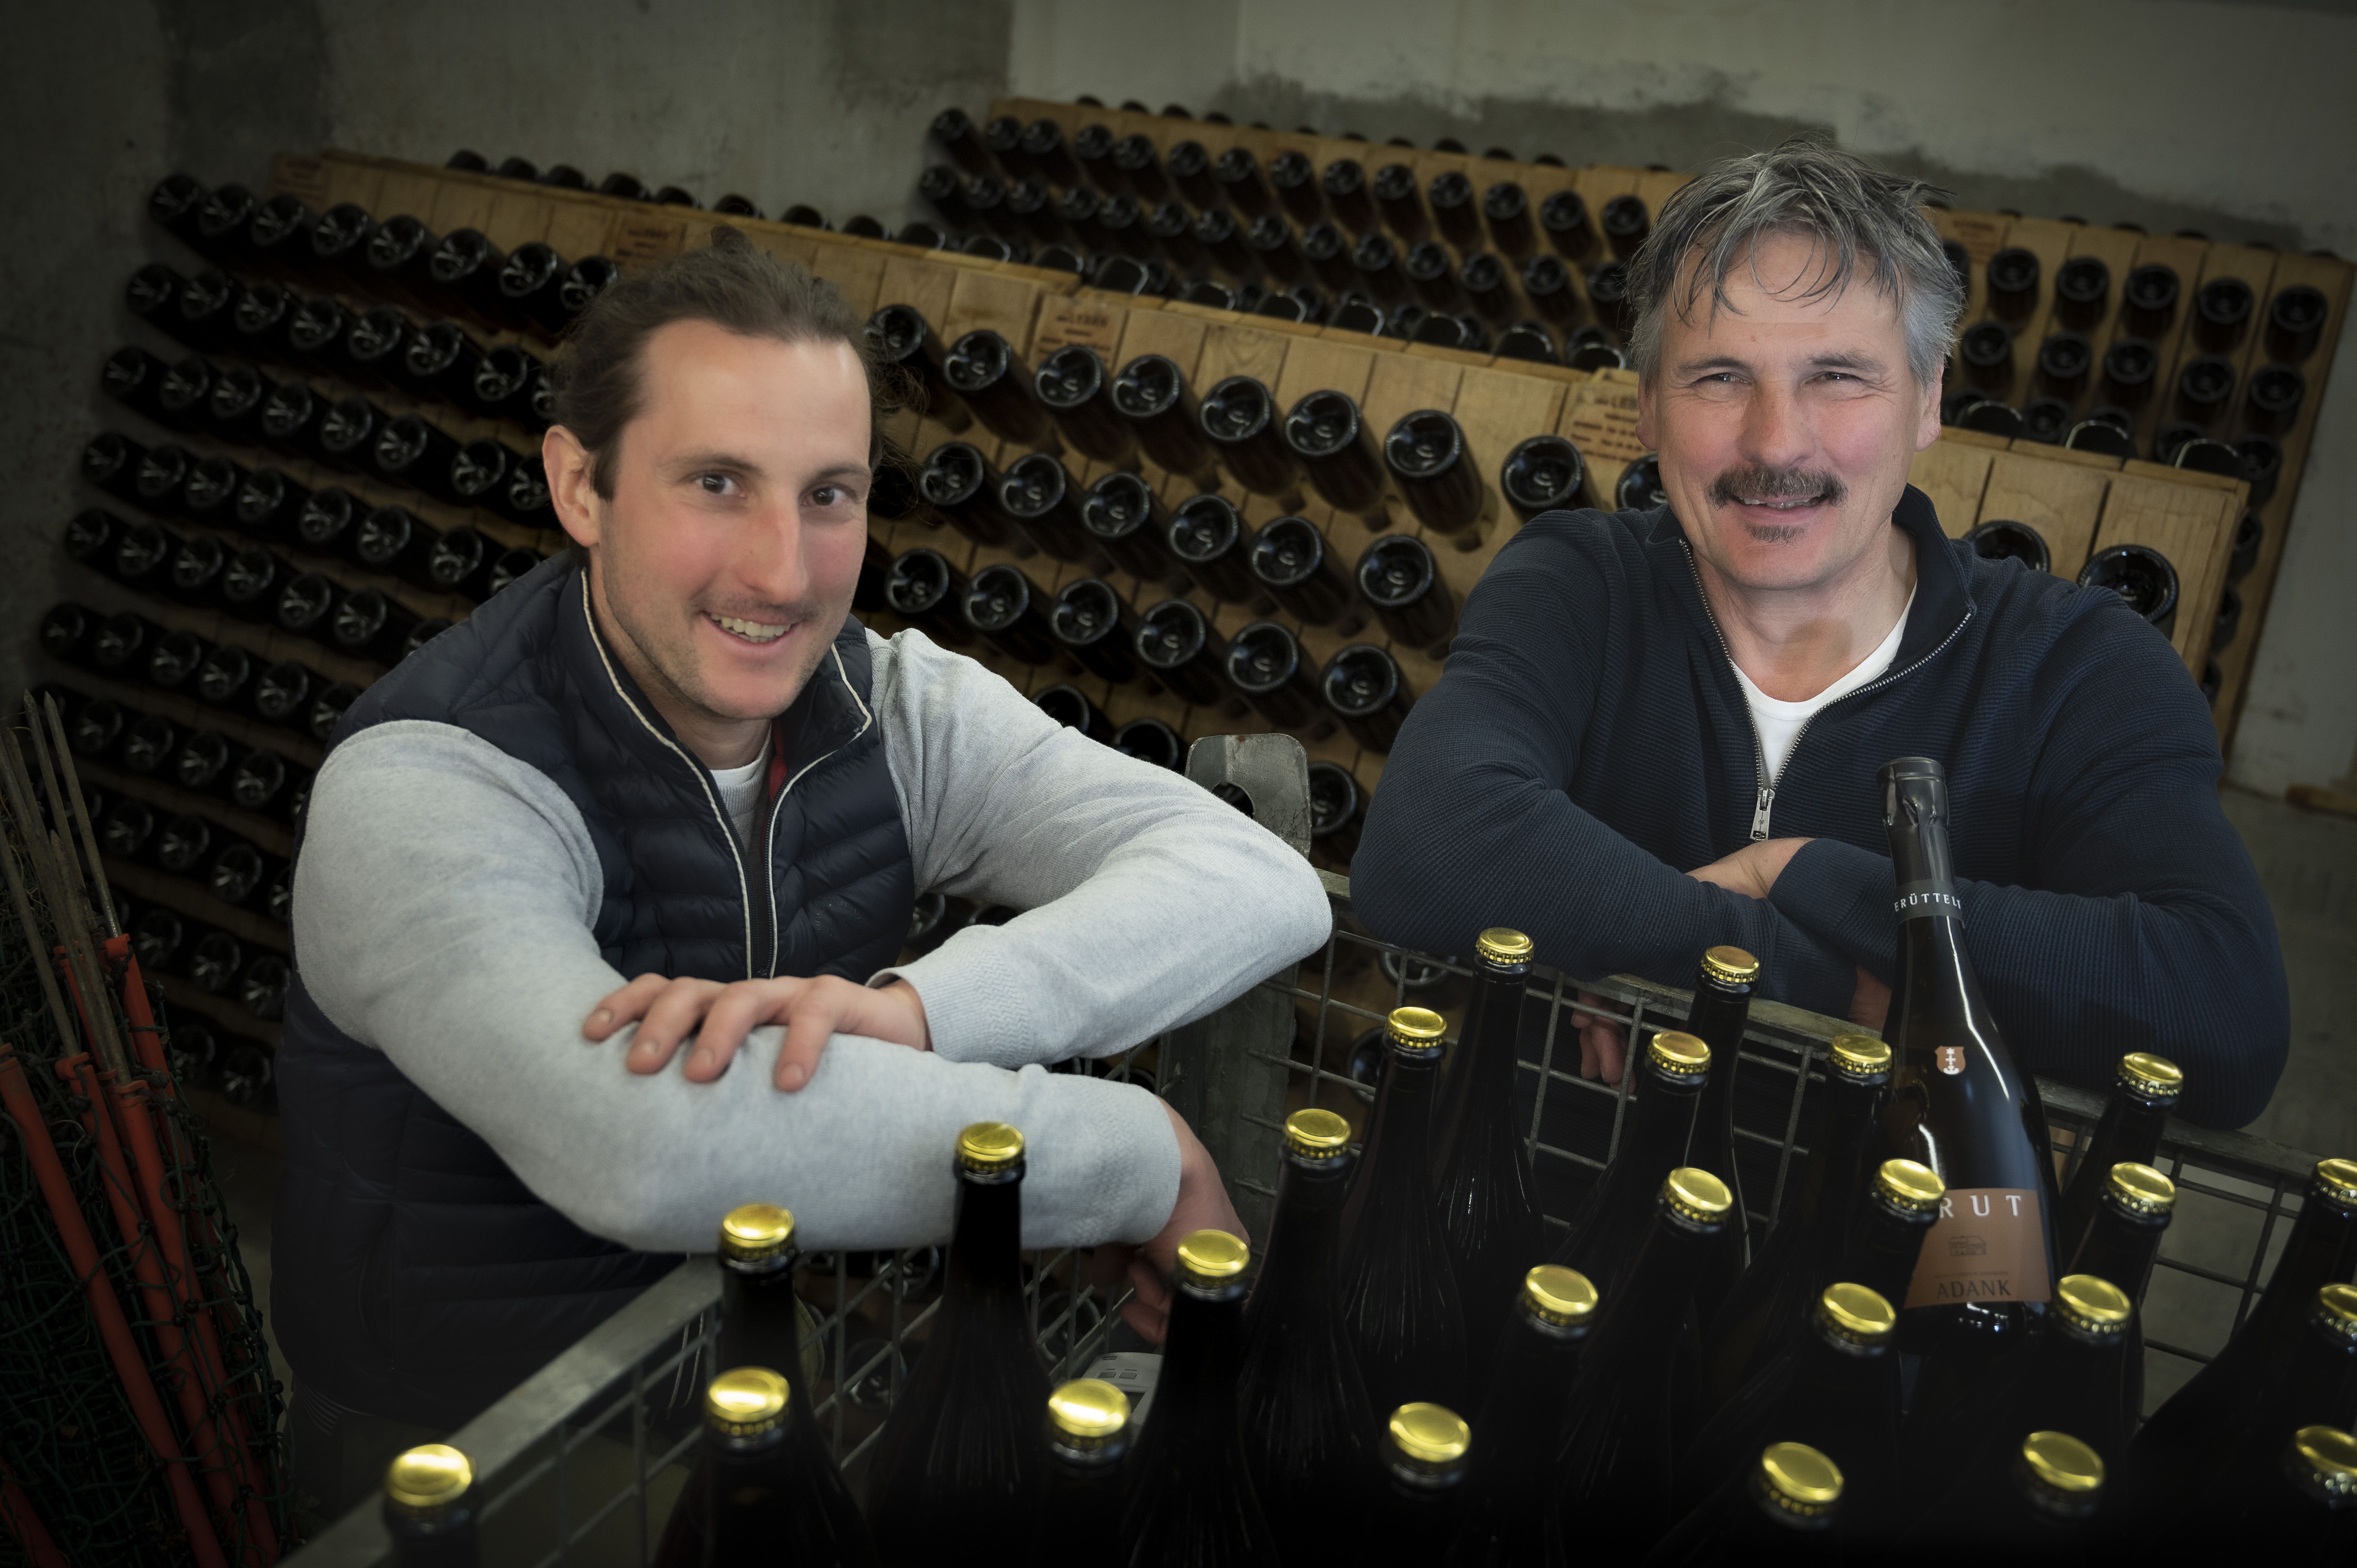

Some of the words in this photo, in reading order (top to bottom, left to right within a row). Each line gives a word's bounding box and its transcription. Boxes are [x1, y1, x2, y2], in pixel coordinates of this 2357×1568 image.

[1894, 893, 1961, 912] ERÜTTELT
[1939, 1195, 2021, 1219] RUT
[1936, 1279, 2011, 1299] ADANK
